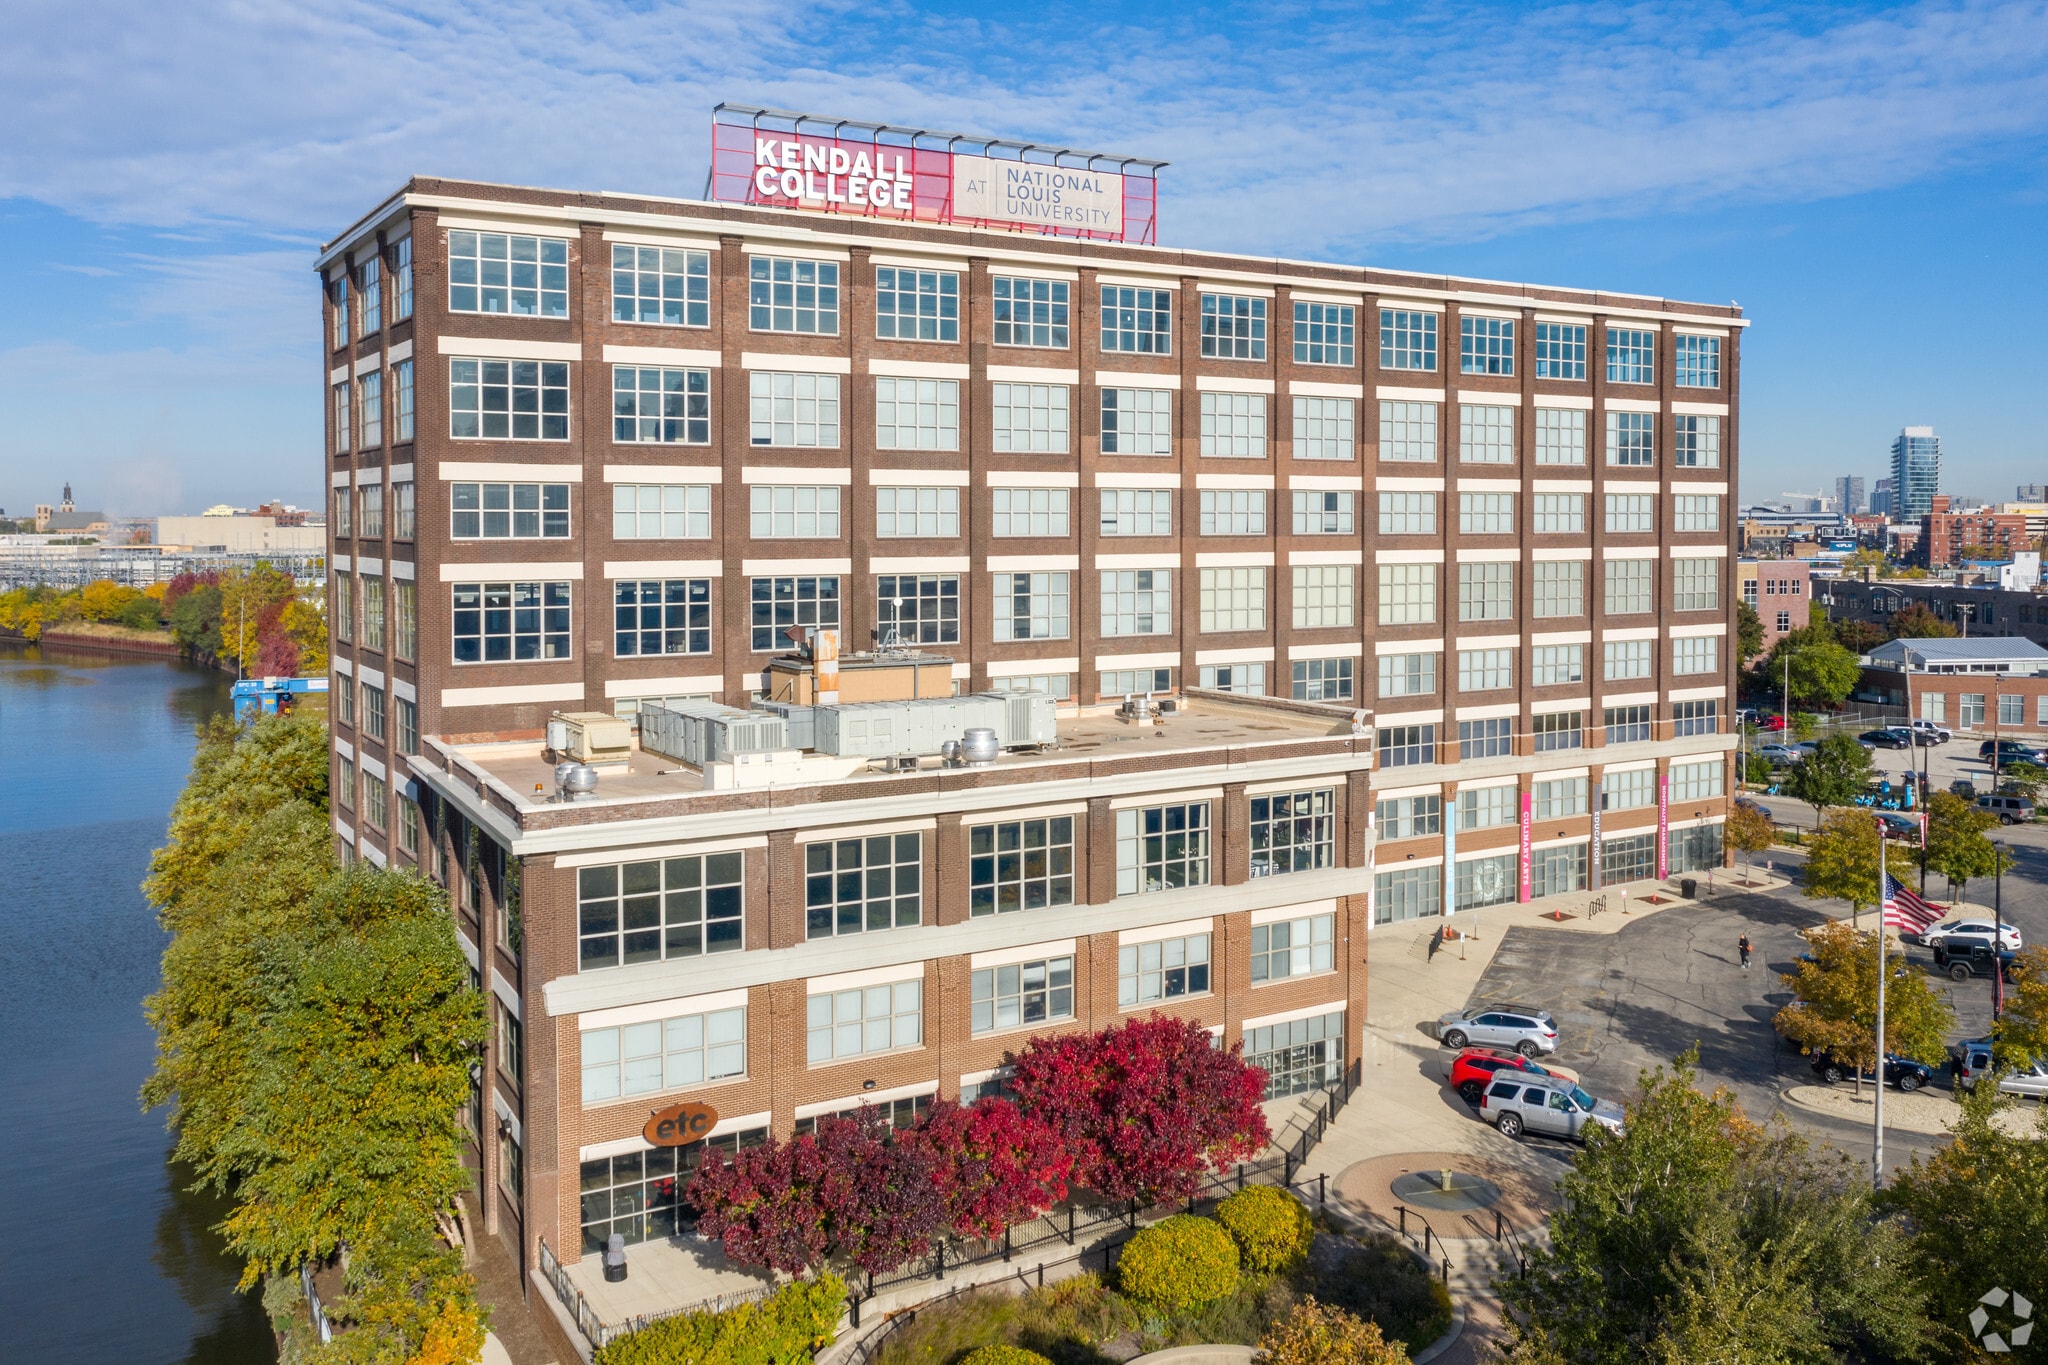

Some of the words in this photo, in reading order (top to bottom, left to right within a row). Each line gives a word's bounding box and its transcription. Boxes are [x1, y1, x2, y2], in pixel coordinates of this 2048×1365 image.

[755, 138, 913, 183] KENDALL
[755, 166, 913, 210] COLLEGE
[966, 179, 988, 194] AT
[1007, 168, 1104, 193] NATIONAL
[1007, 184, 1061, 204] LOUIS
[1007, 200, 1111, 224] UNIVERSITY
[656, 1110, 708, 1139] etc
